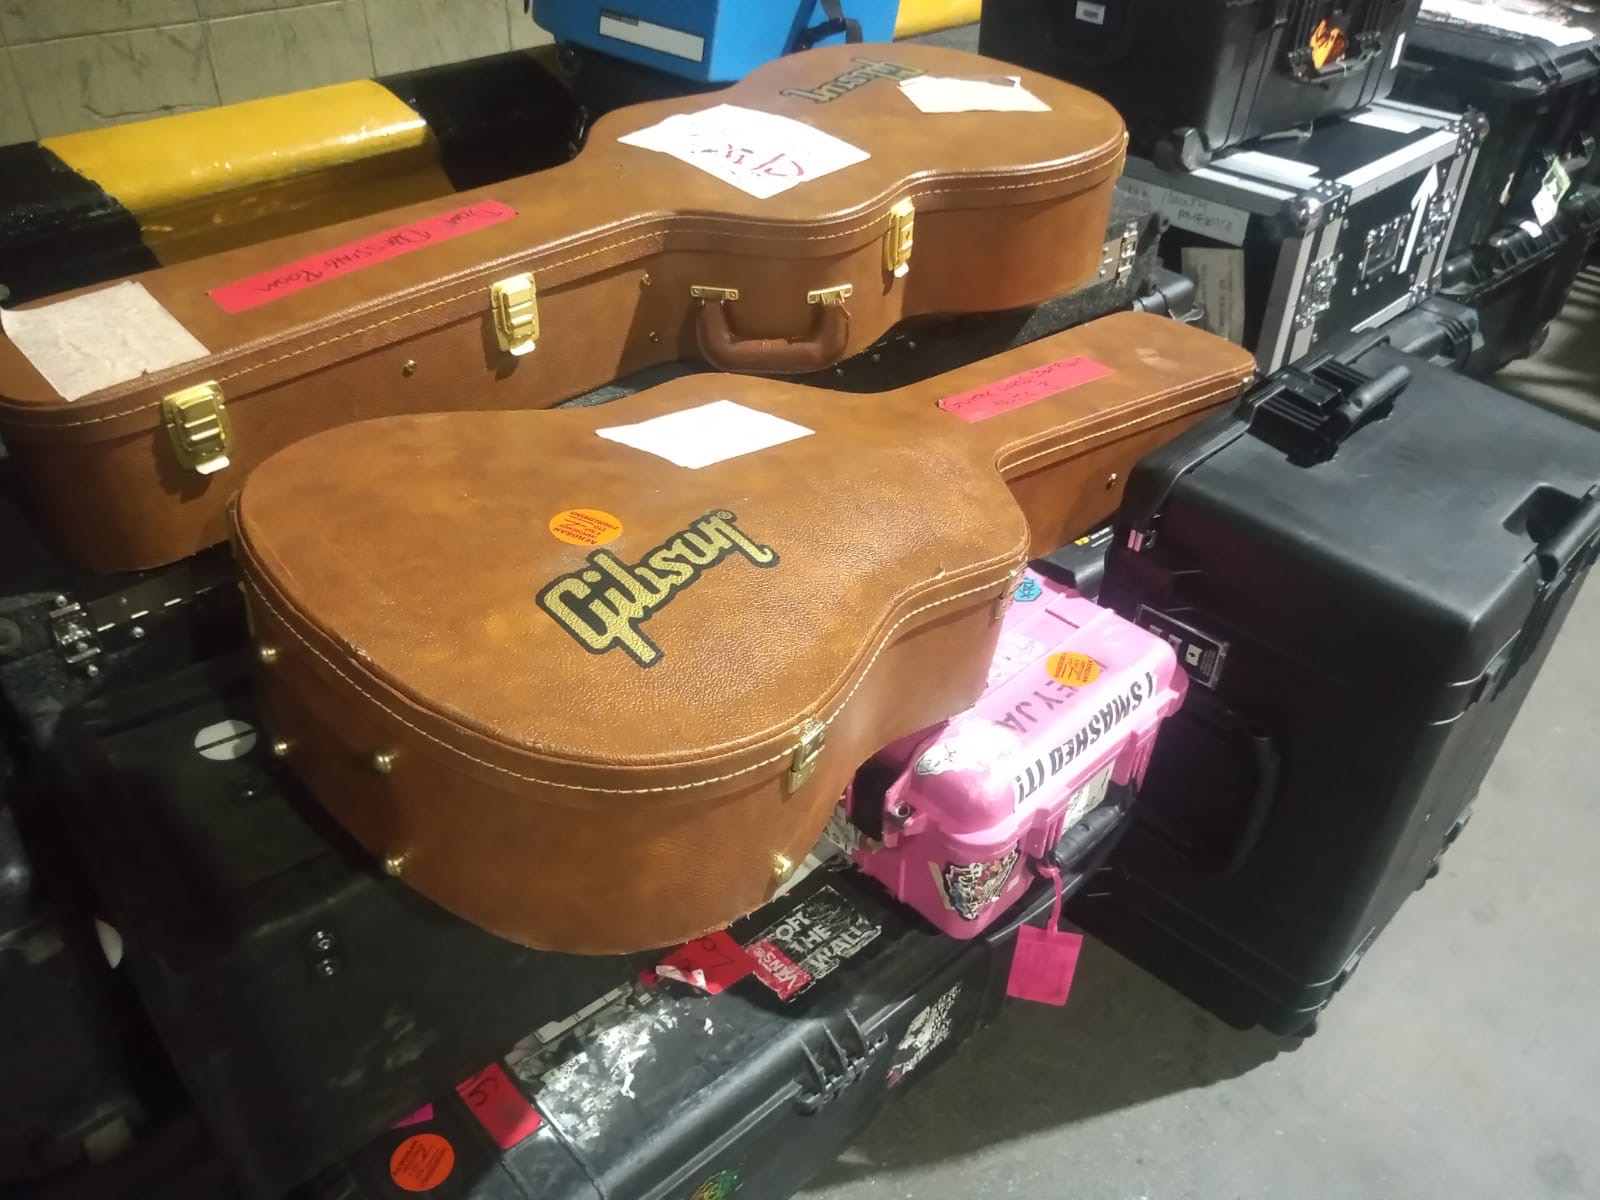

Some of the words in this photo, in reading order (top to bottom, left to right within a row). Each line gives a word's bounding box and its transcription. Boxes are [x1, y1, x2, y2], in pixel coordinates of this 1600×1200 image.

[541, 512, 777, 667] Gibson
[1048, 680, 1143, 777] SMASHED
[1014, 758, 1045, 804] IT!
